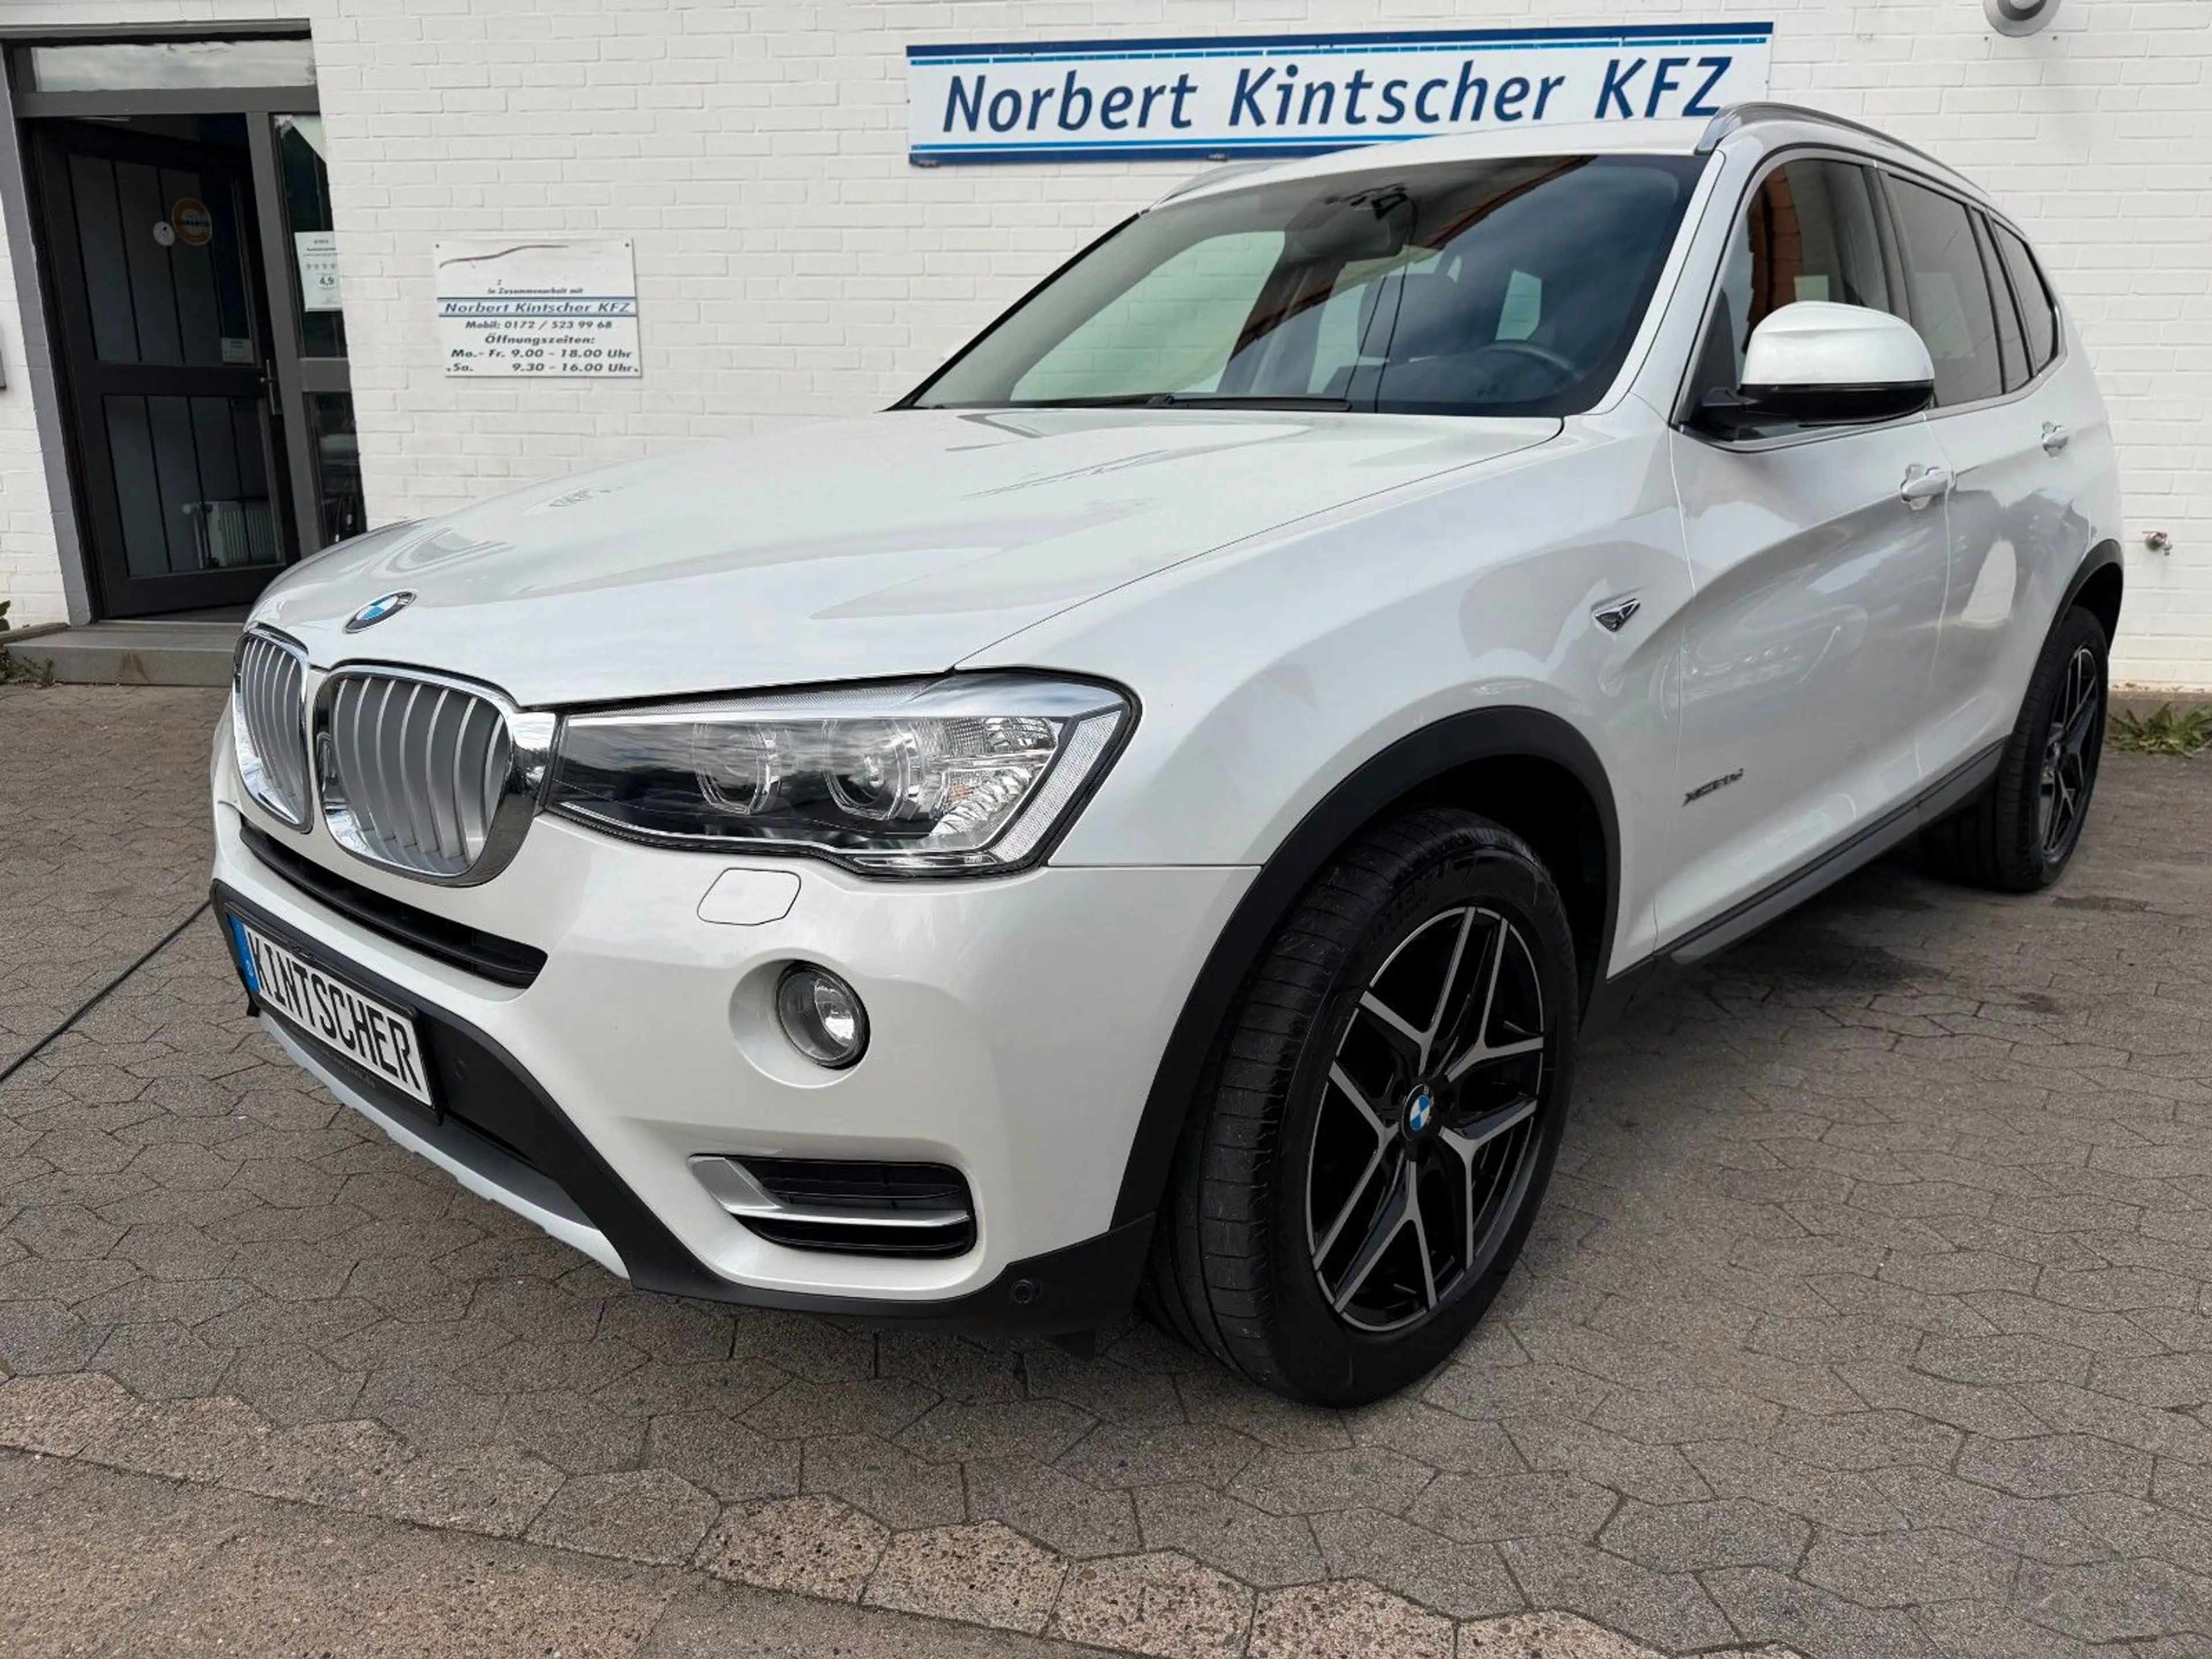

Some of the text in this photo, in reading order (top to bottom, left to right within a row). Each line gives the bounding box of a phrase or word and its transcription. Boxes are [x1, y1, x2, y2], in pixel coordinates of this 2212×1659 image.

[943, 56, 1732, 132] Norbert Kintscher KFZ
[445, 302, 630, 312] Norbert Kintscher KFZ
[465, 320, 501, 329] Mobil:
[504, 320, 535, 329] 0172
[551, 320, 574, 329] 523
[578, 320, 593, 329] 99
[597, 320, 612, 329] 68
[485, 332, 595, 346] Öffnungszeiten:
[489, 349, 505, 358] Fr.
[511, 349, 544, 358] 9.00
[561, 349, 603, 358] 18.00
[607, 349, 632, 358] Uhr
[512, 362, 544, 372] 9.30
[562, 362, 603, 372] 16.00
[608, 362, 632, 372] Uhr
[247, 930, 422, 1091] KINTSCHER
